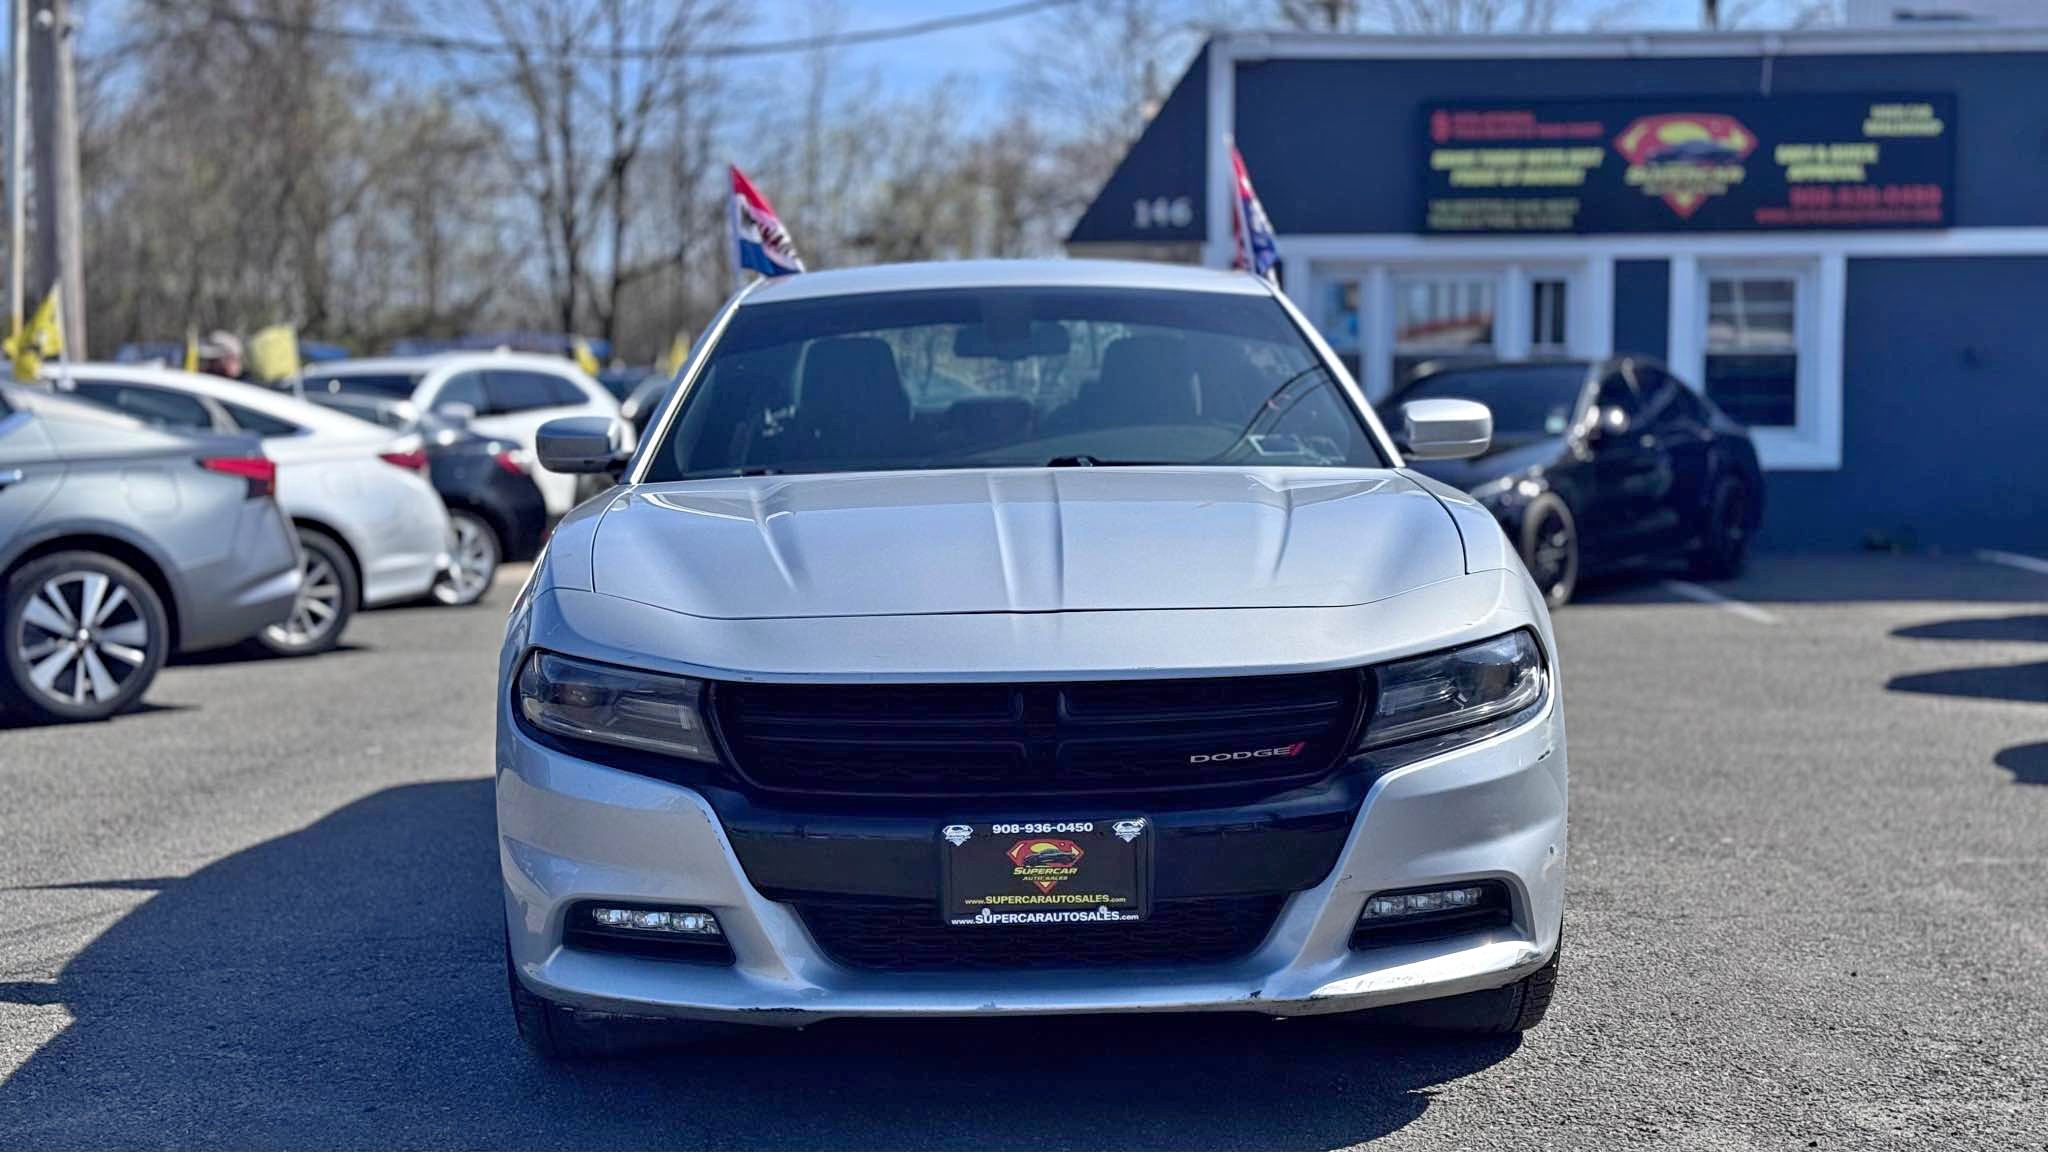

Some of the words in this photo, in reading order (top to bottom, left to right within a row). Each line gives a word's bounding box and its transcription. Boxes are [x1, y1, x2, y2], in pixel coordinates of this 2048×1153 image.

[1190, 745, 1291, 763] DODGE
[992, 822, 1094, 834] 908-936-0450
[1013, 867, 1078, 876] SUPERCAR
[965, 894, 1126, 905] www.SUPERCARAUTOSALES.com
[951, 911, 1139, 925] www.SUPERCARAUTOSALES.com
